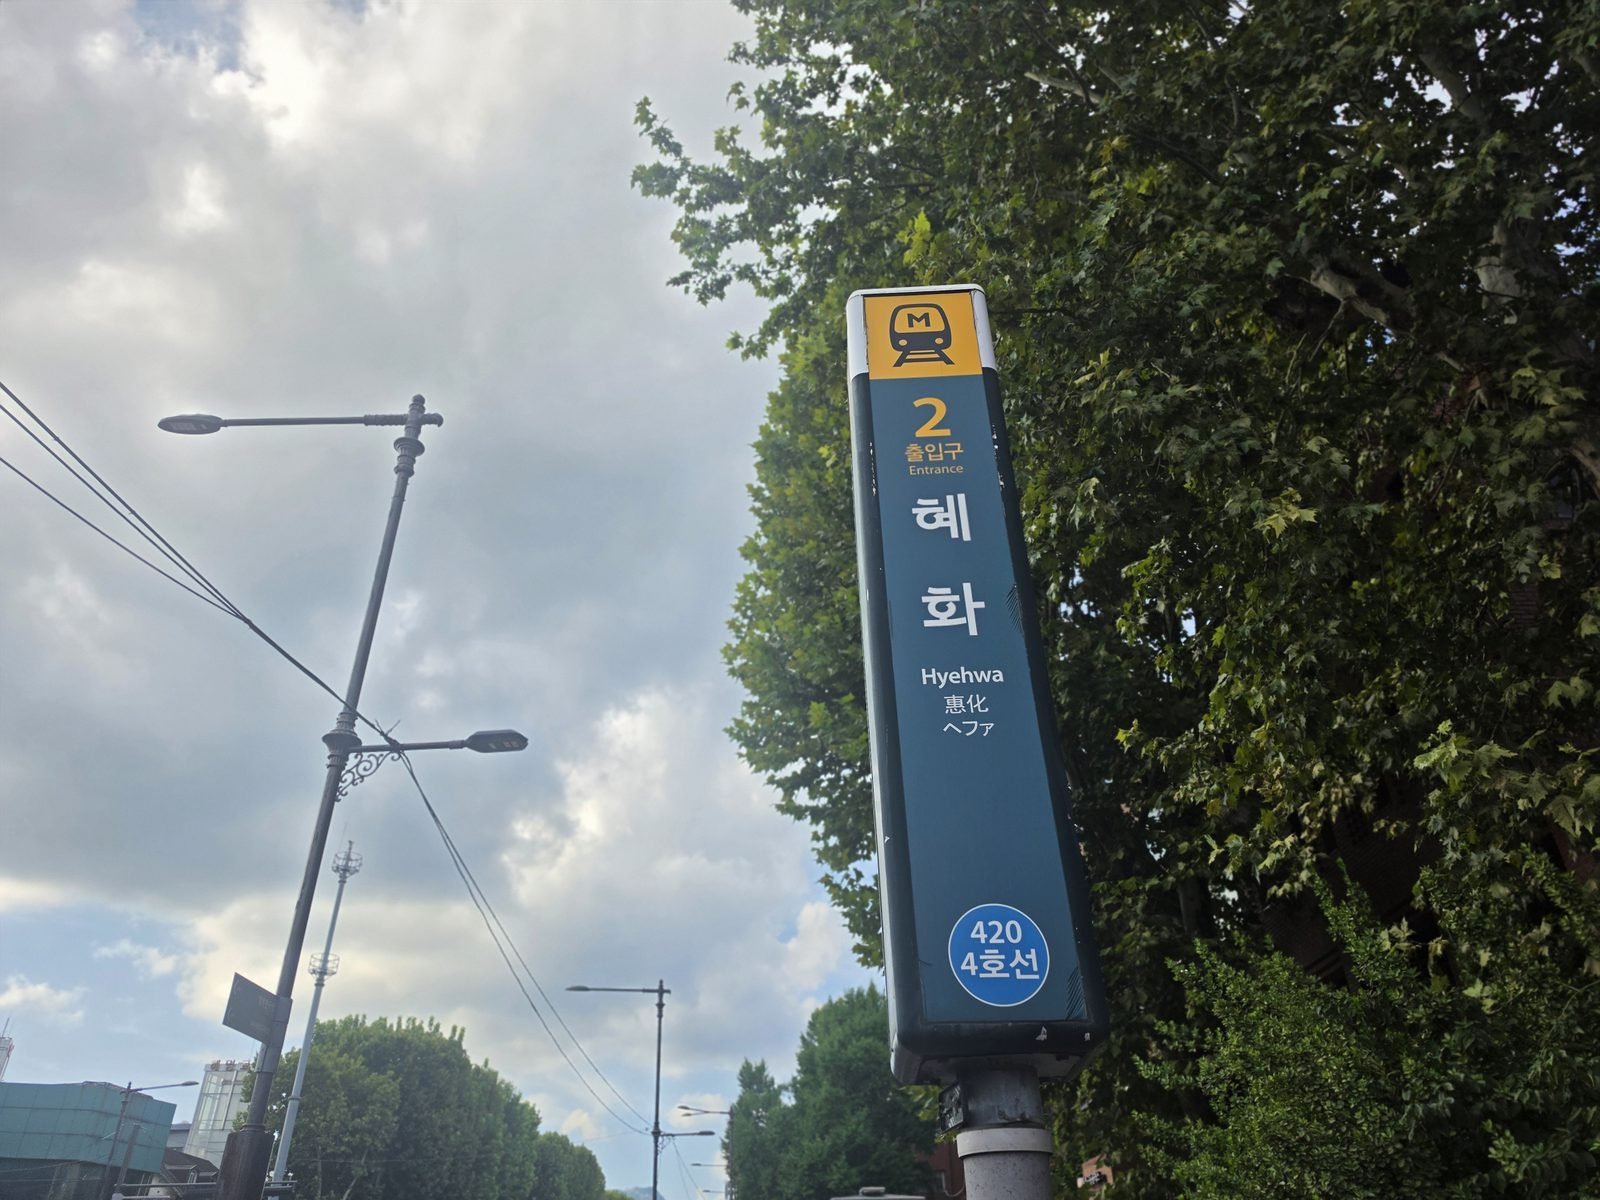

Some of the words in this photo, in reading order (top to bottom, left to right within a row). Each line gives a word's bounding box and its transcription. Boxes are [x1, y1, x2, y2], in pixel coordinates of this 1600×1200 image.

[912, 396, 953, 437] 2
[905, 442, 964, 463] 출입구
[909, 463, 964, 476] Entrance
[921, 666, 1004, 688] Hyehwa
[943, 694, 989, 714] 惠化
[969, 920, 1023, 944] 420
[960, 948, 1040, 981] 4호선
